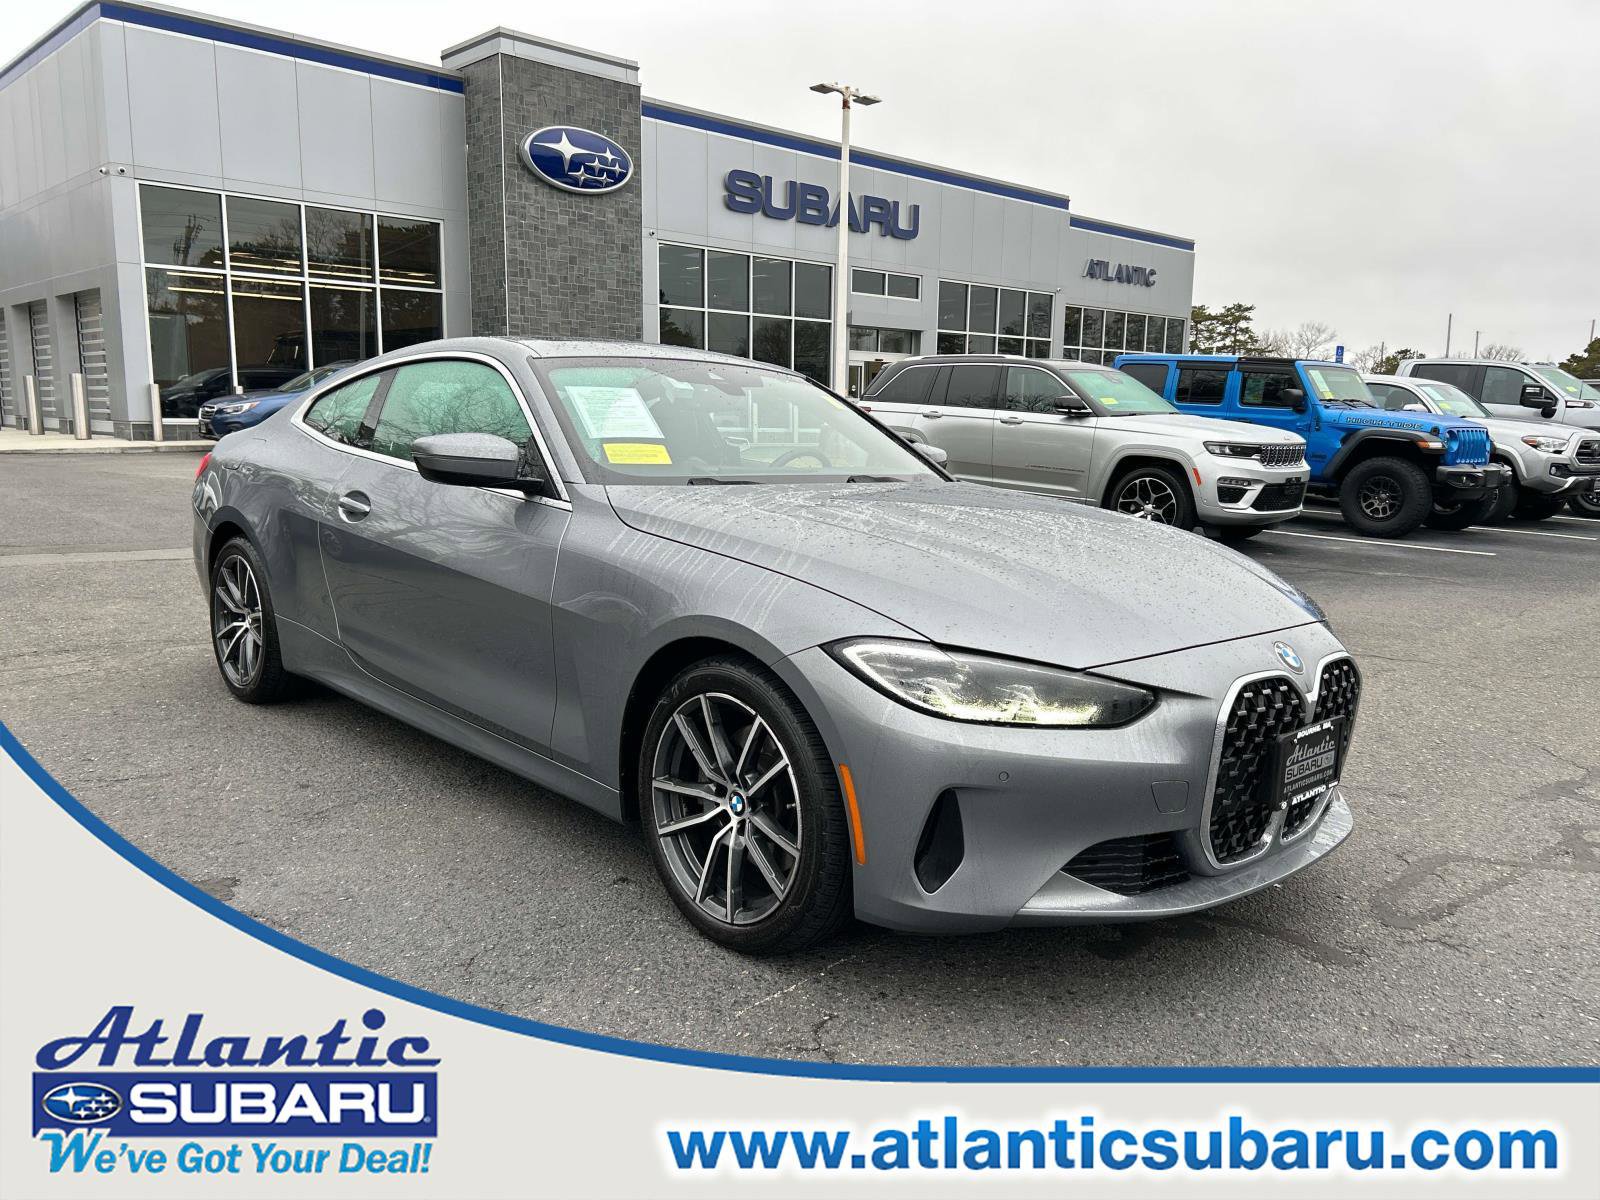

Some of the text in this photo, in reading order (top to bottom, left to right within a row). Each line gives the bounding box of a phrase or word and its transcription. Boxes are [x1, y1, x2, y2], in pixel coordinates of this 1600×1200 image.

[725, 168, 920, 241] SUBARU
[1082, 258, 1157, 287] ATLANTIC
[1285, 734, 1336, 767] Atlantic
[1286, 757, 1323, 780] SUBARU
